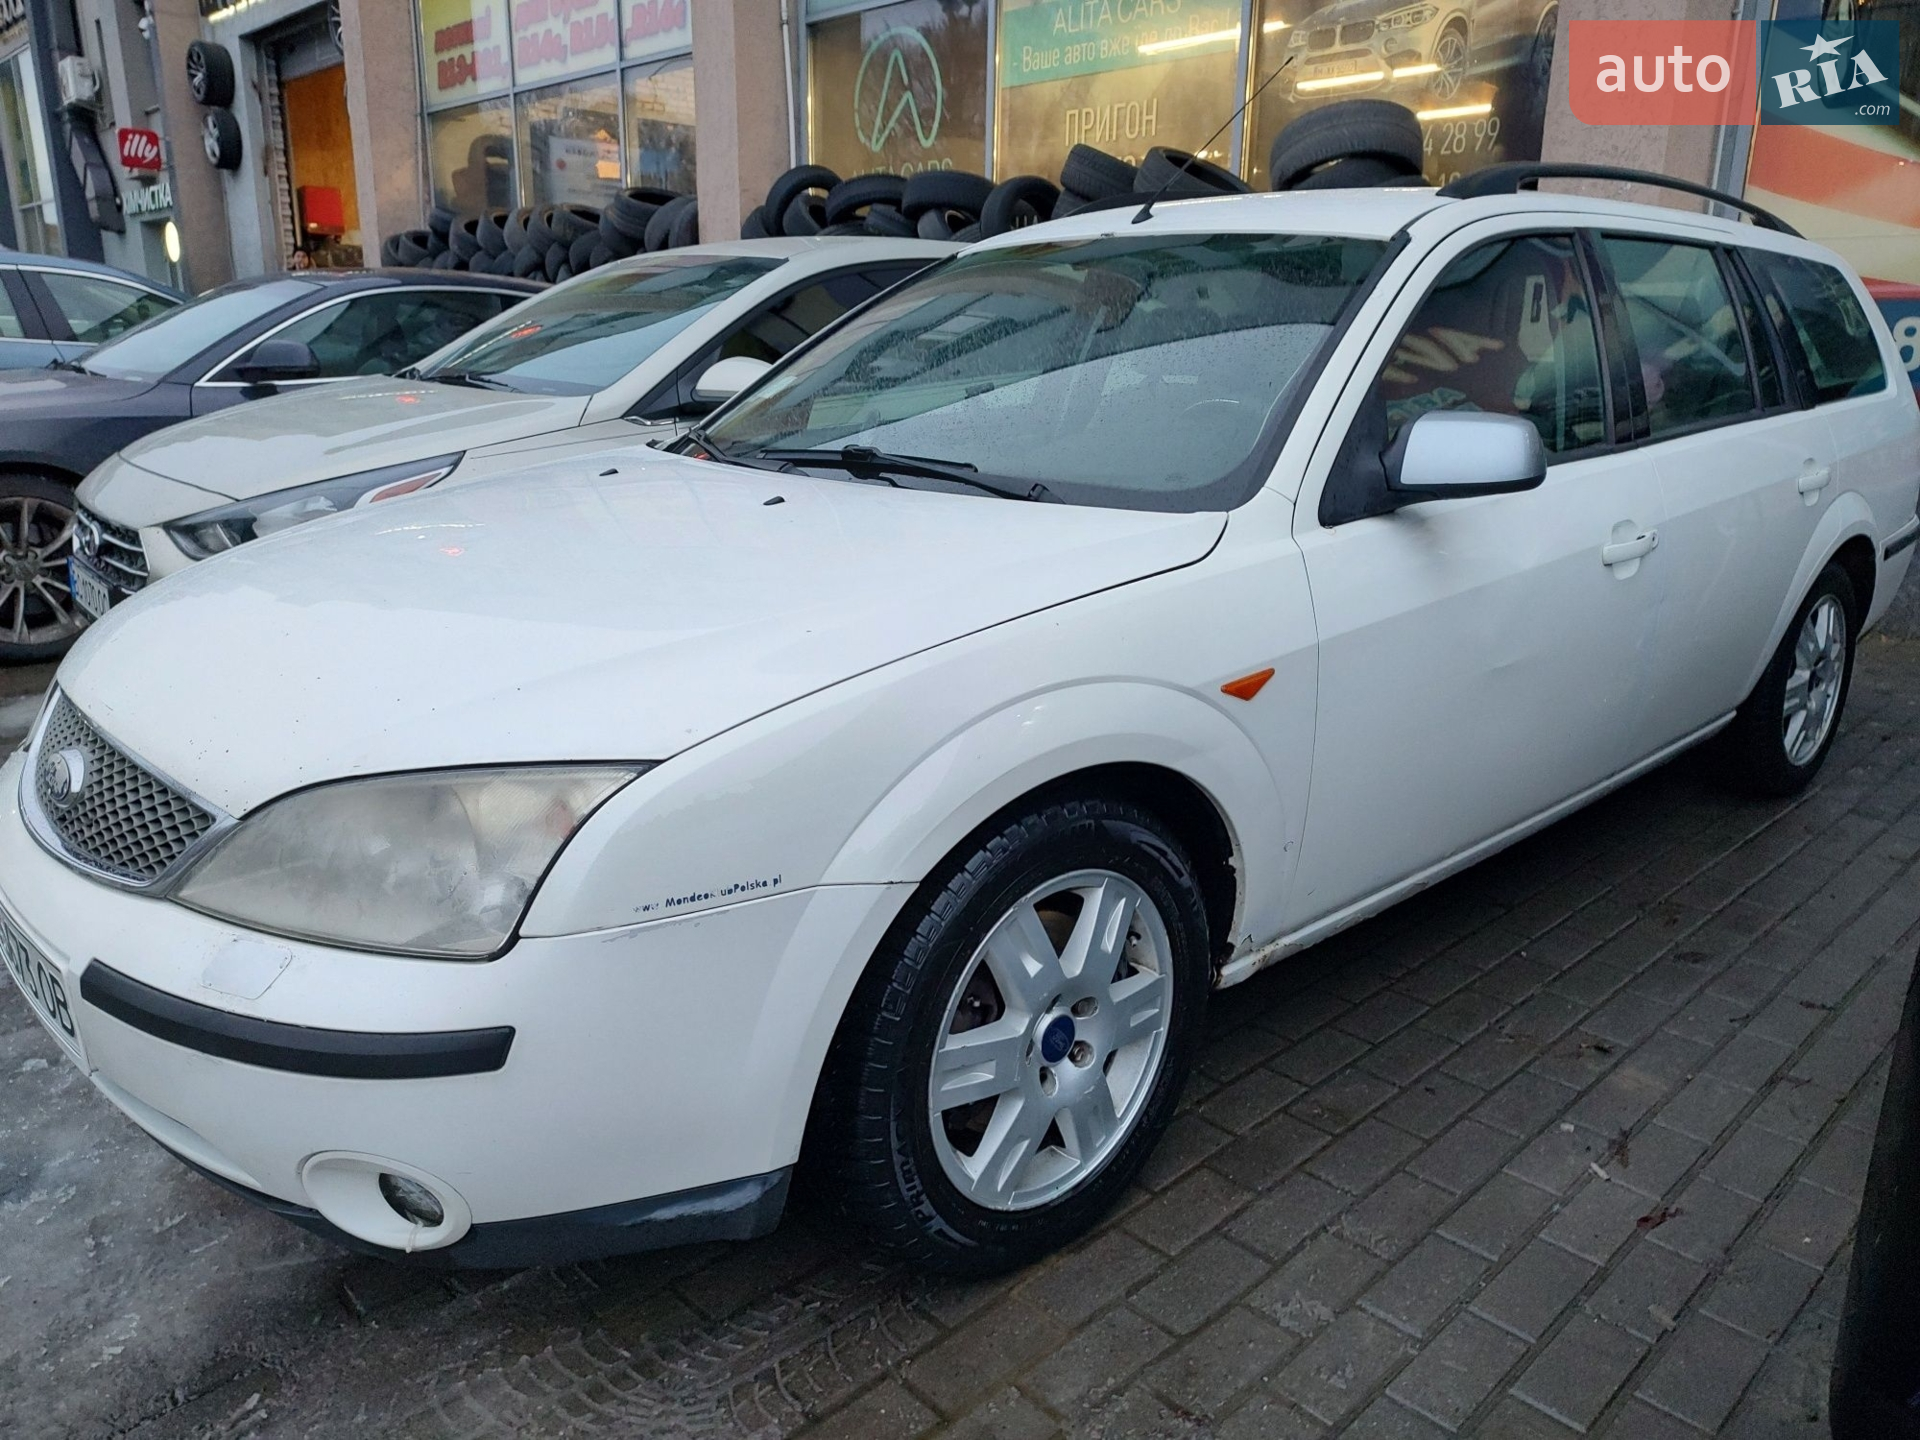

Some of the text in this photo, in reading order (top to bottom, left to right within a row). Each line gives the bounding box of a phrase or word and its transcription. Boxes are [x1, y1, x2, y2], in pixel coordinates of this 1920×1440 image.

[1053, 0, 1113, 35] ALITA
[1022, 45, 1060, 73] Ваше
[1064, 42, 1096, 65] авто
[1100, 35, 1130, 60] вже
[1065, 98, 1158, 147] ПРИГОН
[1440, 121, 1467, 155] 28
[1474, 117, 1500, 151] 99
[123, 133, 158, 164] illy
